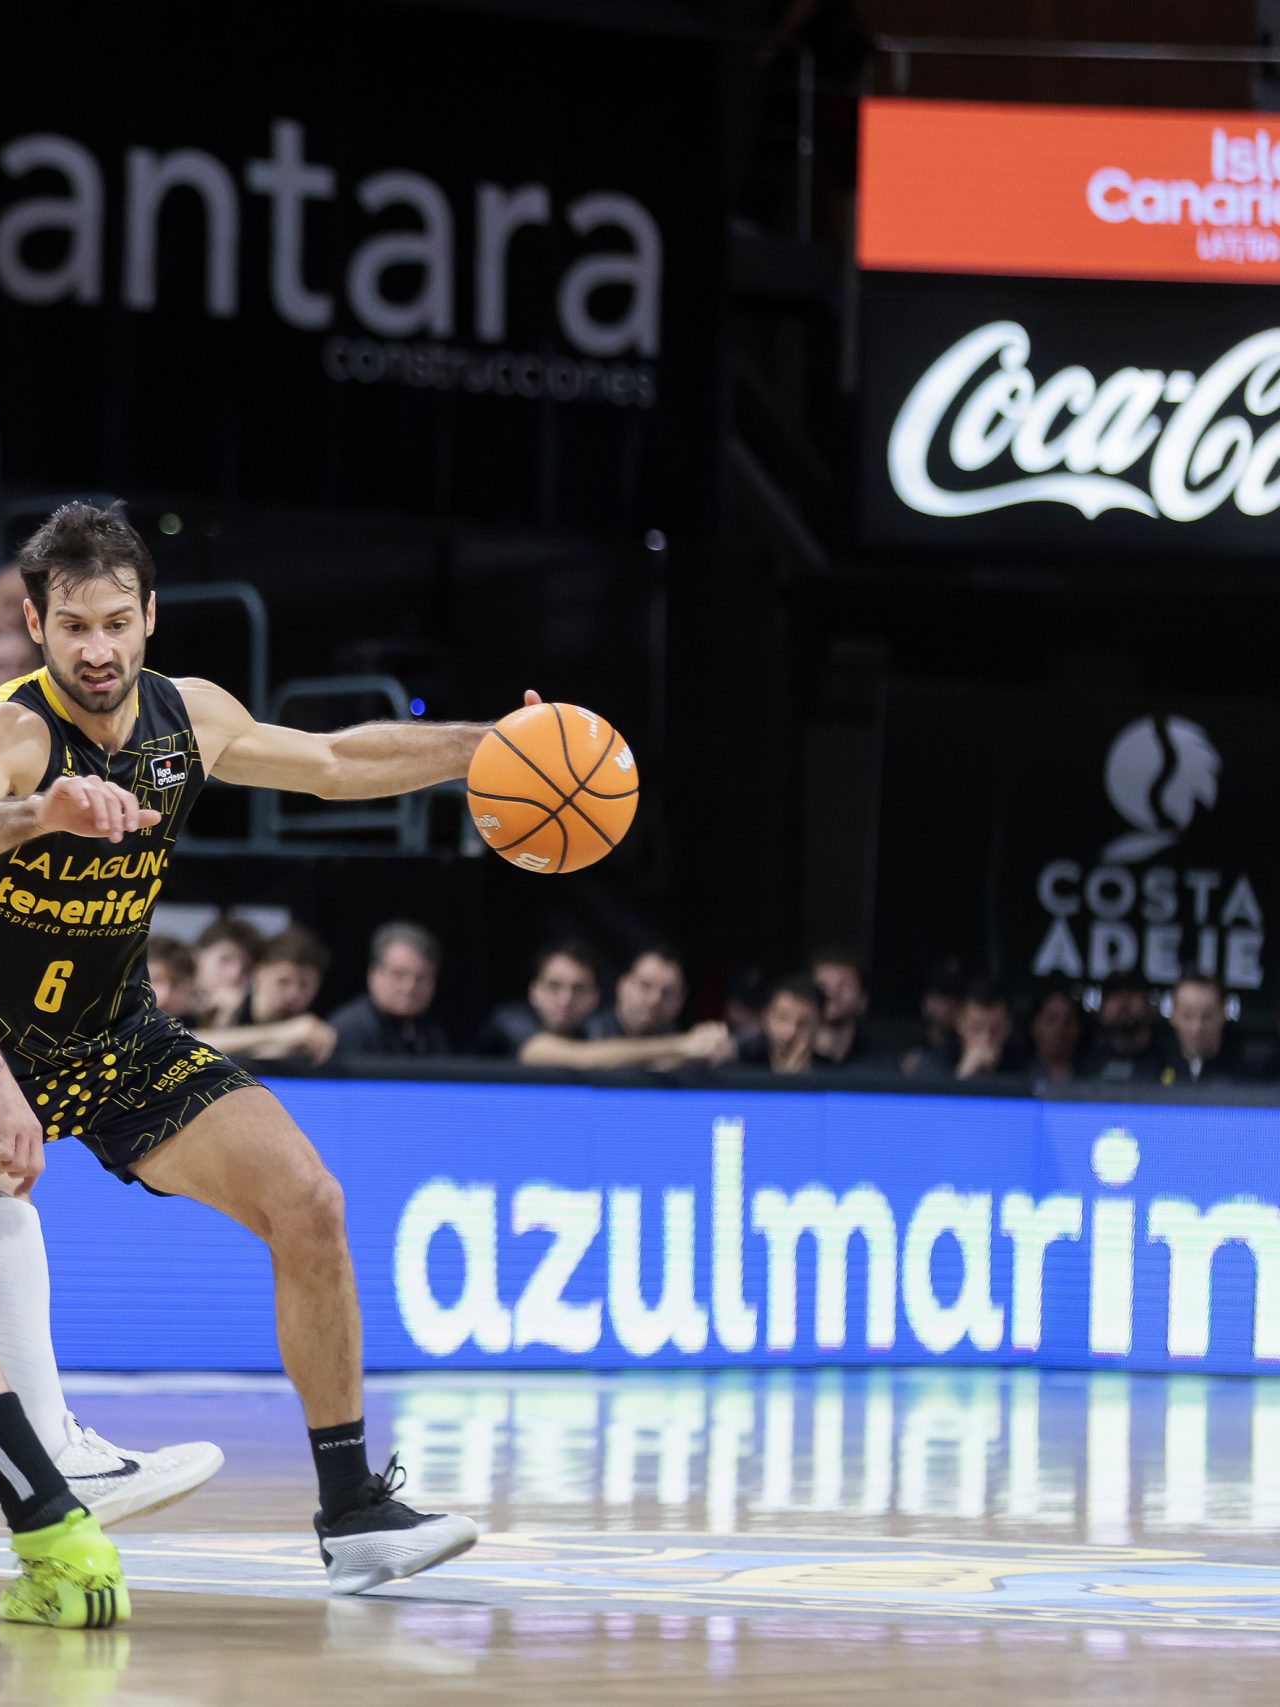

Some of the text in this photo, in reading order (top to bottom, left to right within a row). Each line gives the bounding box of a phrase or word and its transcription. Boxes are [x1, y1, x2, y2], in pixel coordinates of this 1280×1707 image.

[1211, 126, 1280, 184] Isl
[1086, 166, 1280, 228] Canari
[157, 771, 186, 786] endesa
[1036, 858, 1264, 930] COSTA
[33, 959, 75, 1014] 6
[152, 1059, 189, 1092] Islas
[392, 1115, 1280, 1361] azulmarin
